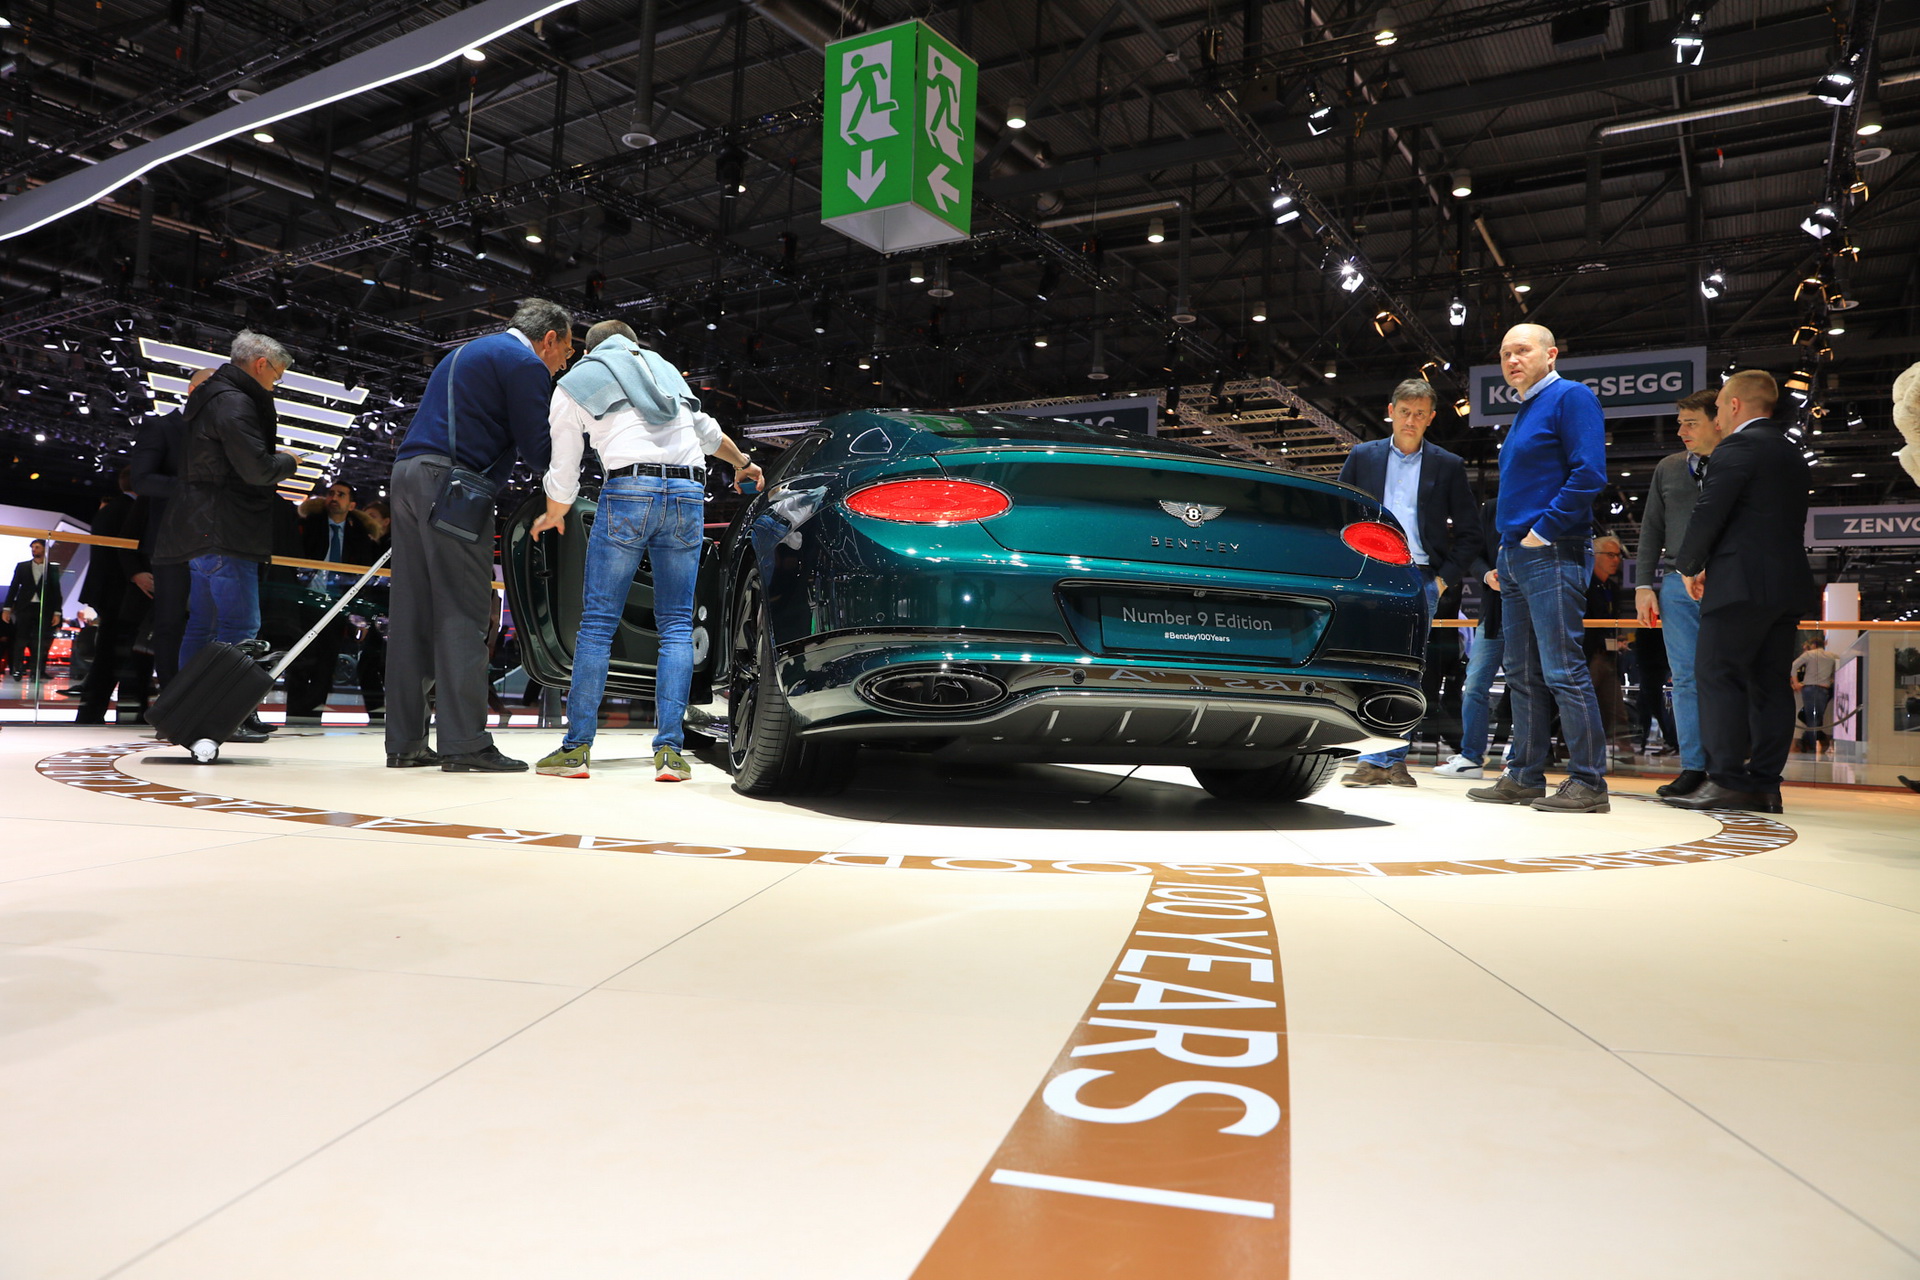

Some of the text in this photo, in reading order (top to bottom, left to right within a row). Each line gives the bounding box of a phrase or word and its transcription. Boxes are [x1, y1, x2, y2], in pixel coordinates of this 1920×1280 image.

[1150, 535, 1240, 553] BENTLEY
[1122, 606, 1273, 631] Number 9 Edition
[1164, 631, 1231, 642] #Bentley100Years
[42, 769, 151, 787] CAR
[101, 790, 340, 819] FAST
[351, 816, 452, 829] A
[467, 828, 747, 857] CAR
[819, 852, 1261, 876] GOOD
[1504, 845, 1762, 872] YEARS
[1146, 881, 1268, 920] 100
[1042, 930, 1281, 1137] YEARS
